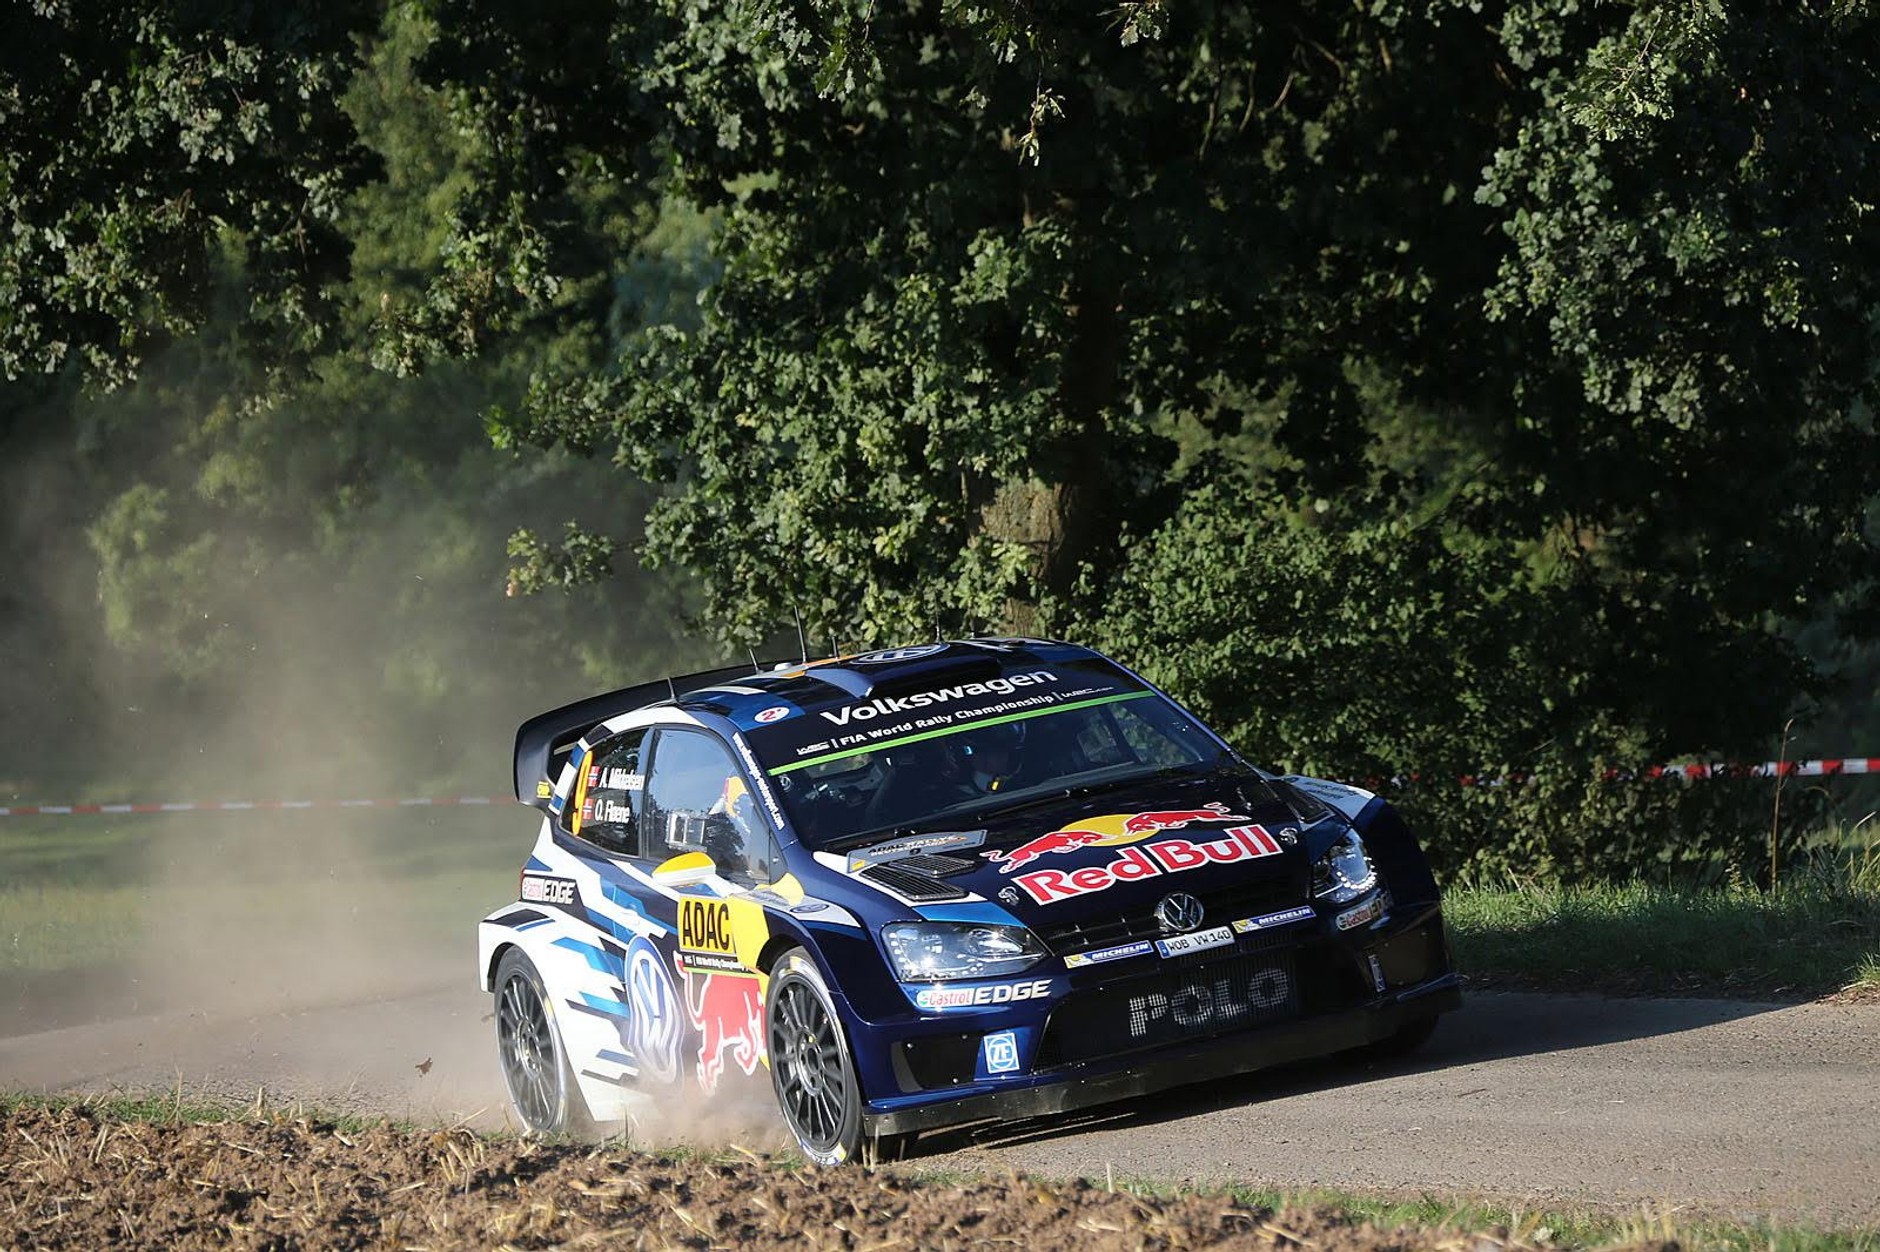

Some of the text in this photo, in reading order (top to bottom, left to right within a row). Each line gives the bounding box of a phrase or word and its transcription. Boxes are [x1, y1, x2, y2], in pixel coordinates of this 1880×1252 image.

[820, 670, 1058, 726] Volkswagen
[841, 735, 867, 746] FIA
[867, 722, 913, 740] World
[915, 713, 953, 729] Rally
[955, 695, 1054, 719] Championship
[572, 750, 593, 836] 9
[542, 880, 576, 904] EDGE
[682, 901, 730, 950] ADAC
[1259, 908, 1311, 925] MICHELIN
[1091, 944, 1149, 960] MICHELIN
[1167, 938, 1190, 951] WOB
[929, 979, 1053, 1006] Castrol EDGE
[1129, 968, 1288, 1037] POLO
[992, 1044, 1011, 1063] ZF
